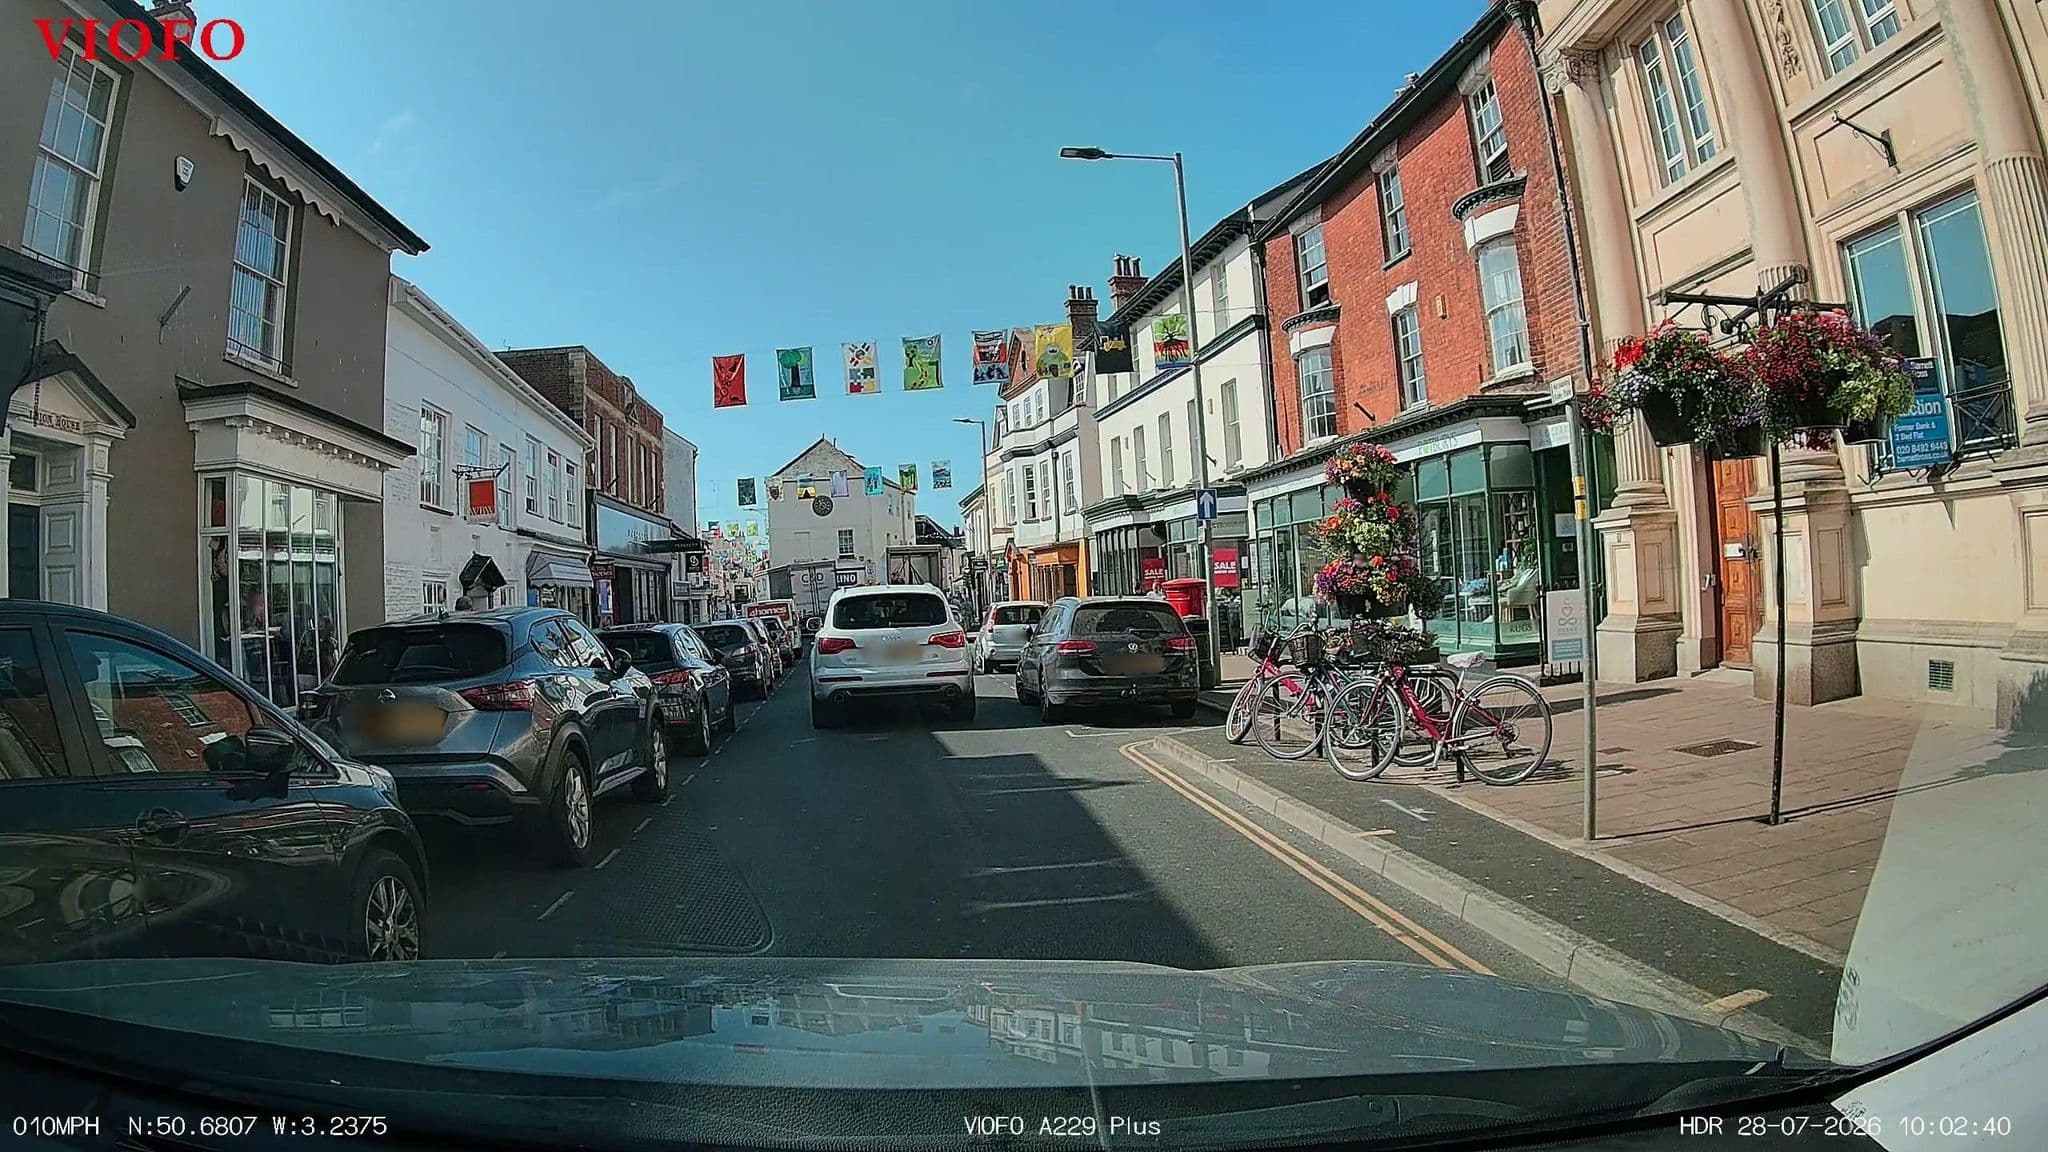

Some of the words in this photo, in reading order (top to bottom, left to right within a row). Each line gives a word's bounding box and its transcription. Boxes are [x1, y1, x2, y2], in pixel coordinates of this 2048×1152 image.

[1898, 399, 1941, 416] ction
[1896, 446, 1910, 455] 020
[1214, 561, 1236, 570] SALE
[1144, 568, 1164, 576] SALE
